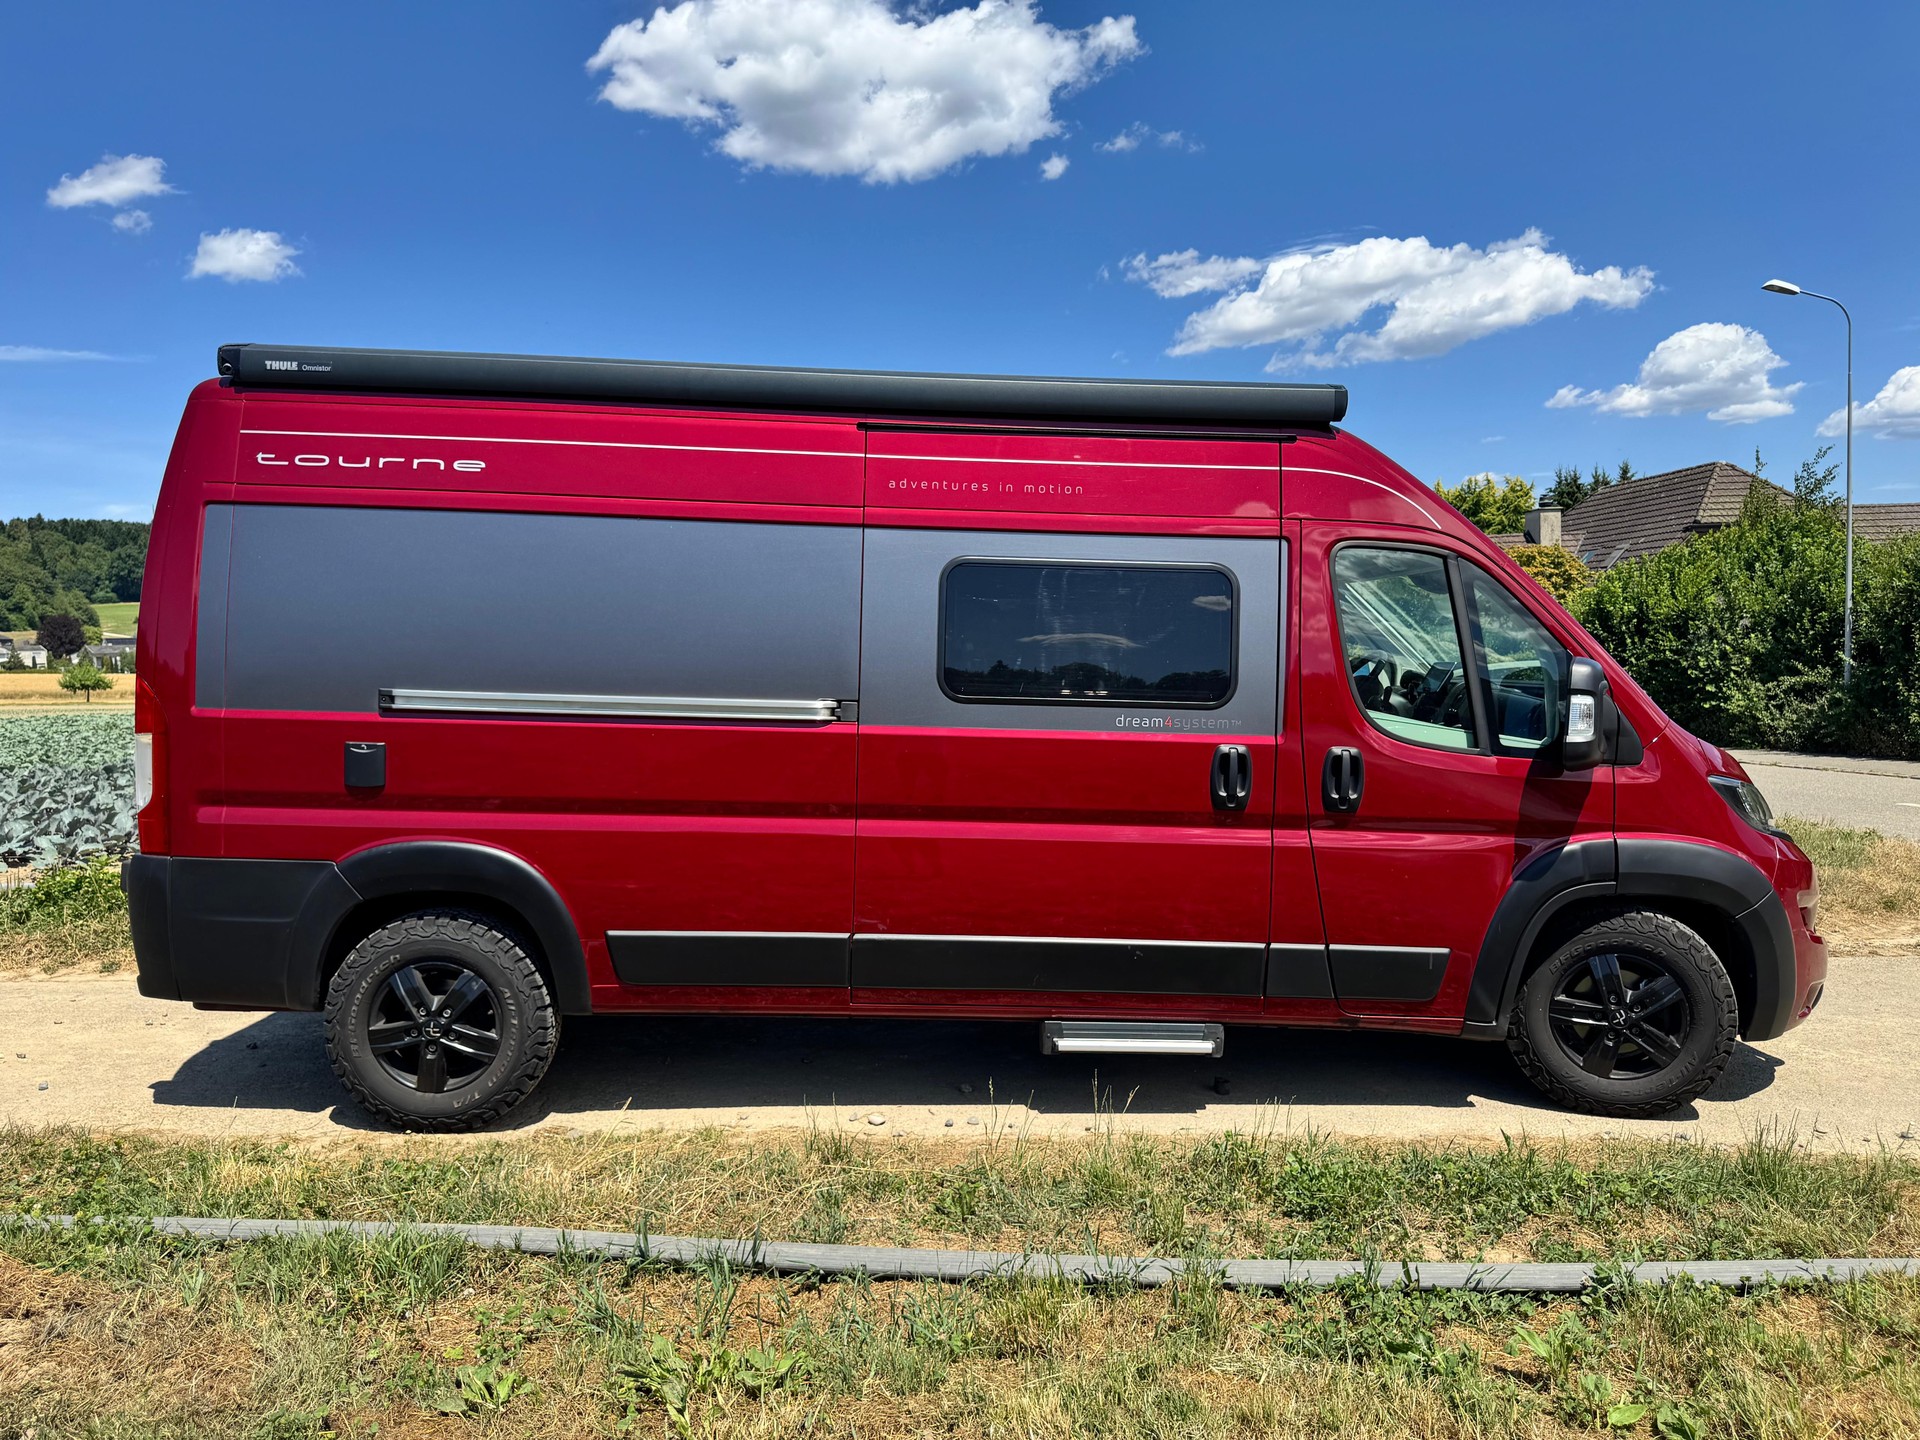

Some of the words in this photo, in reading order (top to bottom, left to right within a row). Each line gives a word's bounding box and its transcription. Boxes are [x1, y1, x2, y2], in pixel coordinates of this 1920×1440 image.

[265, 360, 298, 371] THULE
[302, 363, 332, 372] Omnistor
[256, 451, 486, 472] tourne
[888, 478, 989, 492] adventures
[999, 481, 1013, 493] in
[1024, 483, 1083, 494] motion
